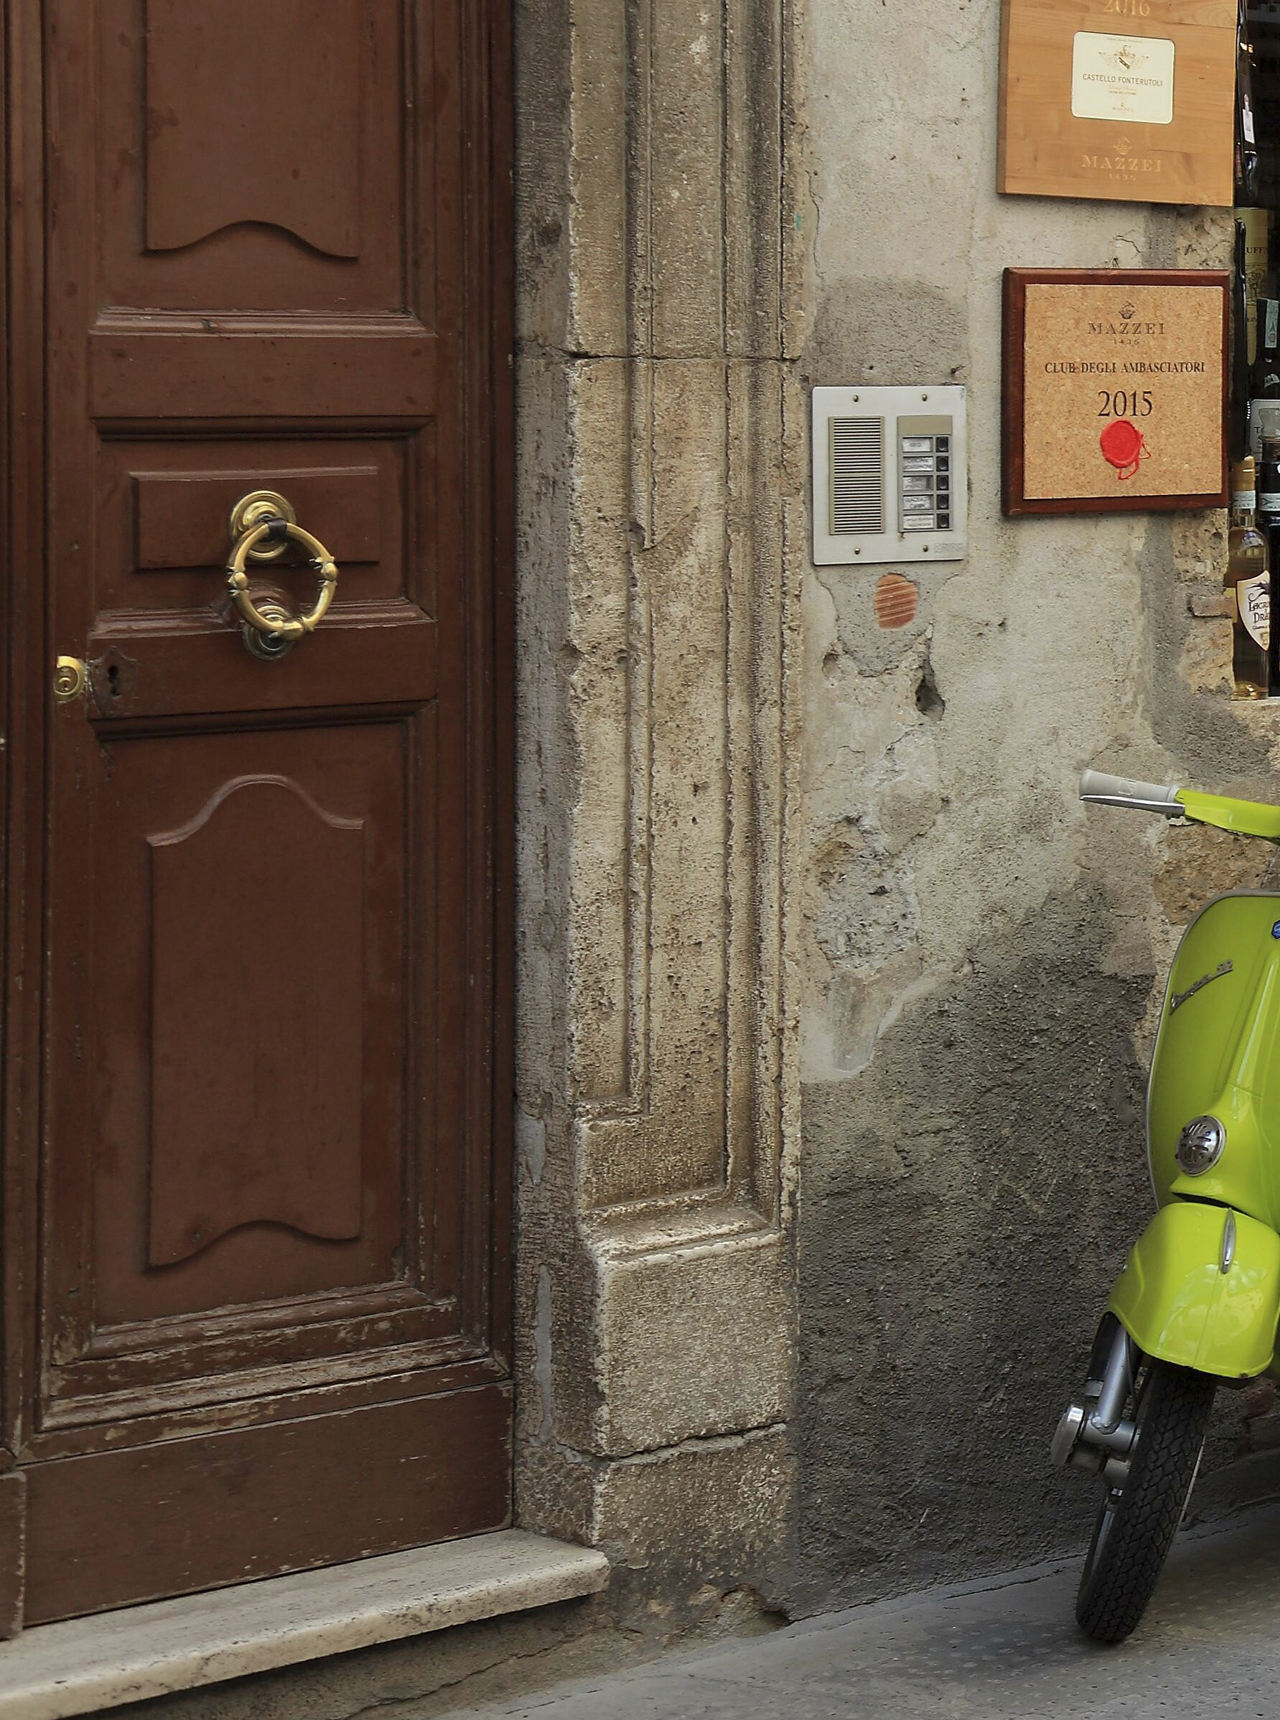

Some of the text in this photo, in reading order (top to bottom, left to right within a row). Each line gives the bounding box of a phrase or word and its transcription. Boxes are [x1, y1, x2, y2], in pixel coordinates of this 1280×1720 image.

[1103, 0, 1150, 17] 2016
[1082, 73, 1163, 86] CASTELLO FONTERUTOLI
[1081, 154, 1162, 173] MAZZEI
[1088, 322, 1166, 335] MAZZEI
[1044, 360, 1206, 374] CLUB DEGLI AMBASCIATORI
[1097, 390, 1154, 417] 2015
